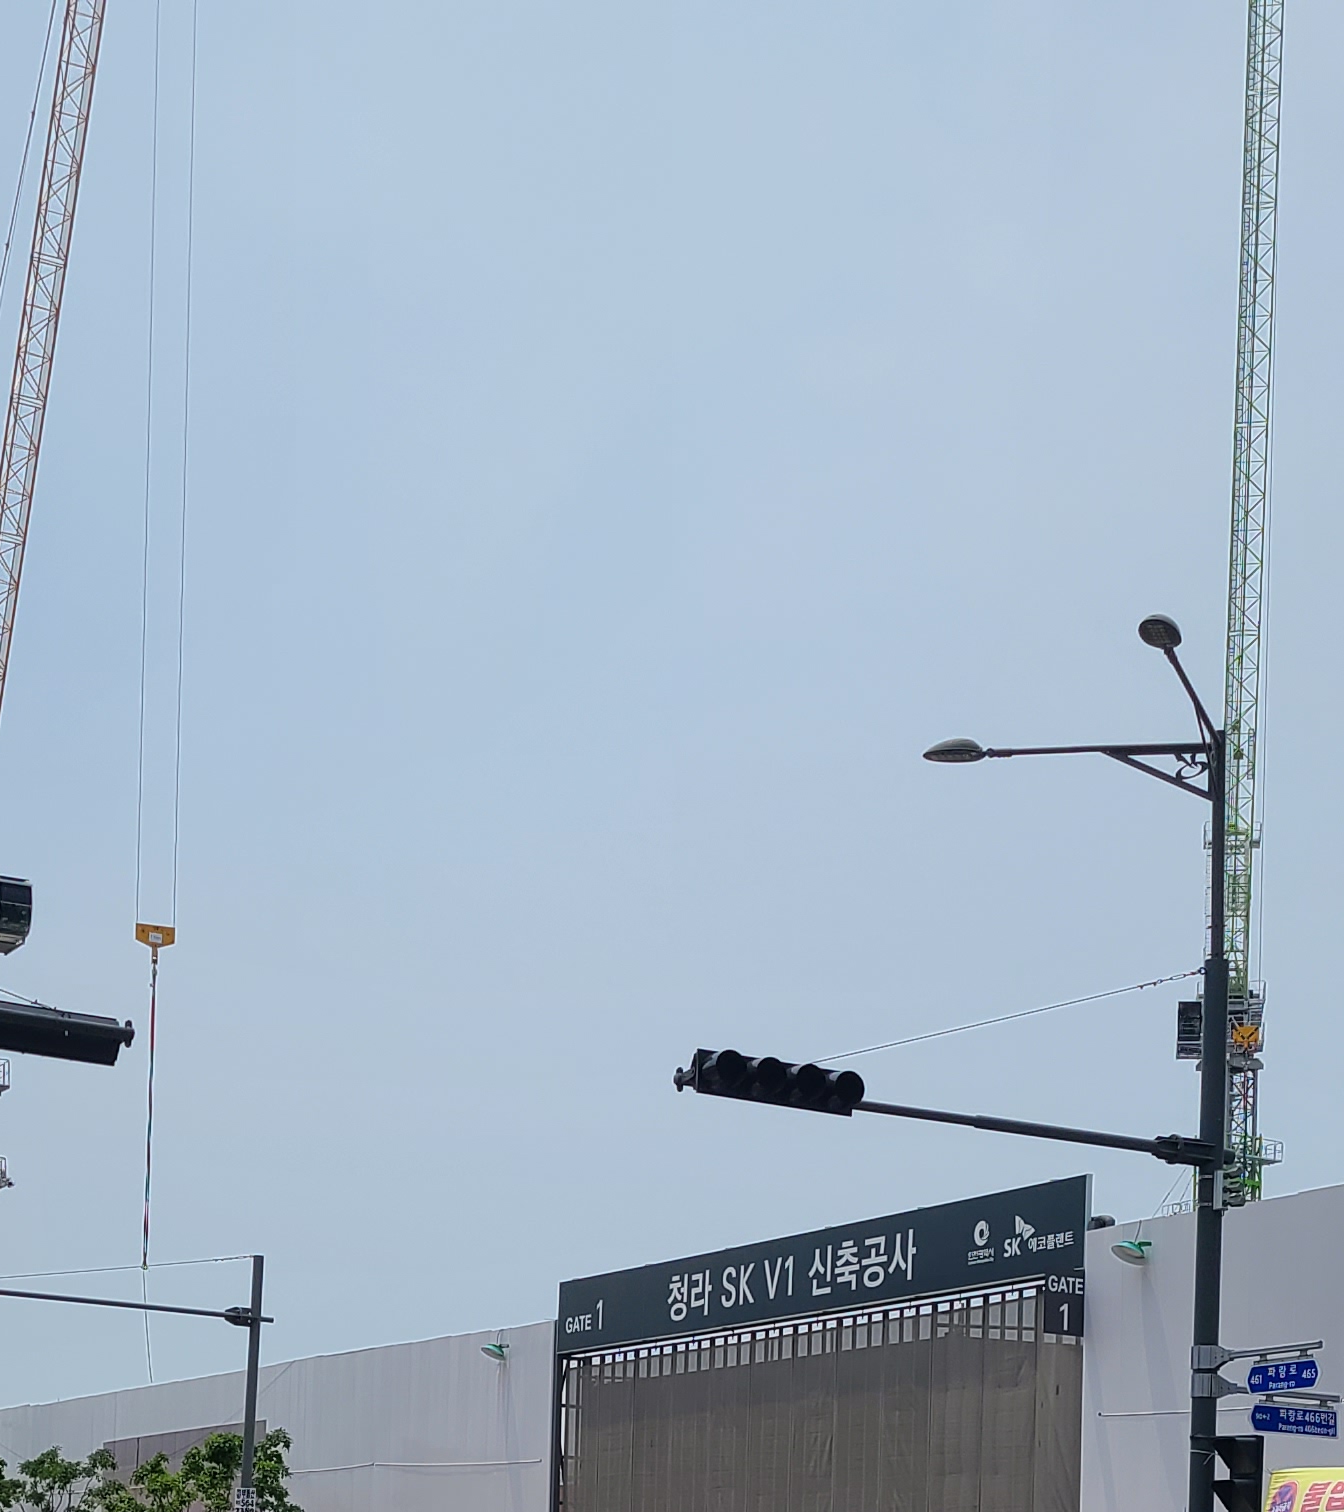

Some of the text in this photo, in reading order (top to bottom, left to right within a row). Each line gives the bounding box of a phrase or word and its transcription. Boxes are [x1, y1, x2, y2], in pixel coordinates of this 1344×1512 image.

[1003, 1230, 1074, 1258] SK 에코플랜트
[667, 1228, 917, 1322] 청라 SK V1 신축공사
[1048, 1274, 1084, 1295] GATE
[565, 1299, 604, 1334] GATE 1
[1059, 1302, 1069, 1331] 1
[1268, 1364, 1297, 1378] 파랑로
[1301, 1368, 1316, 1379] 465
